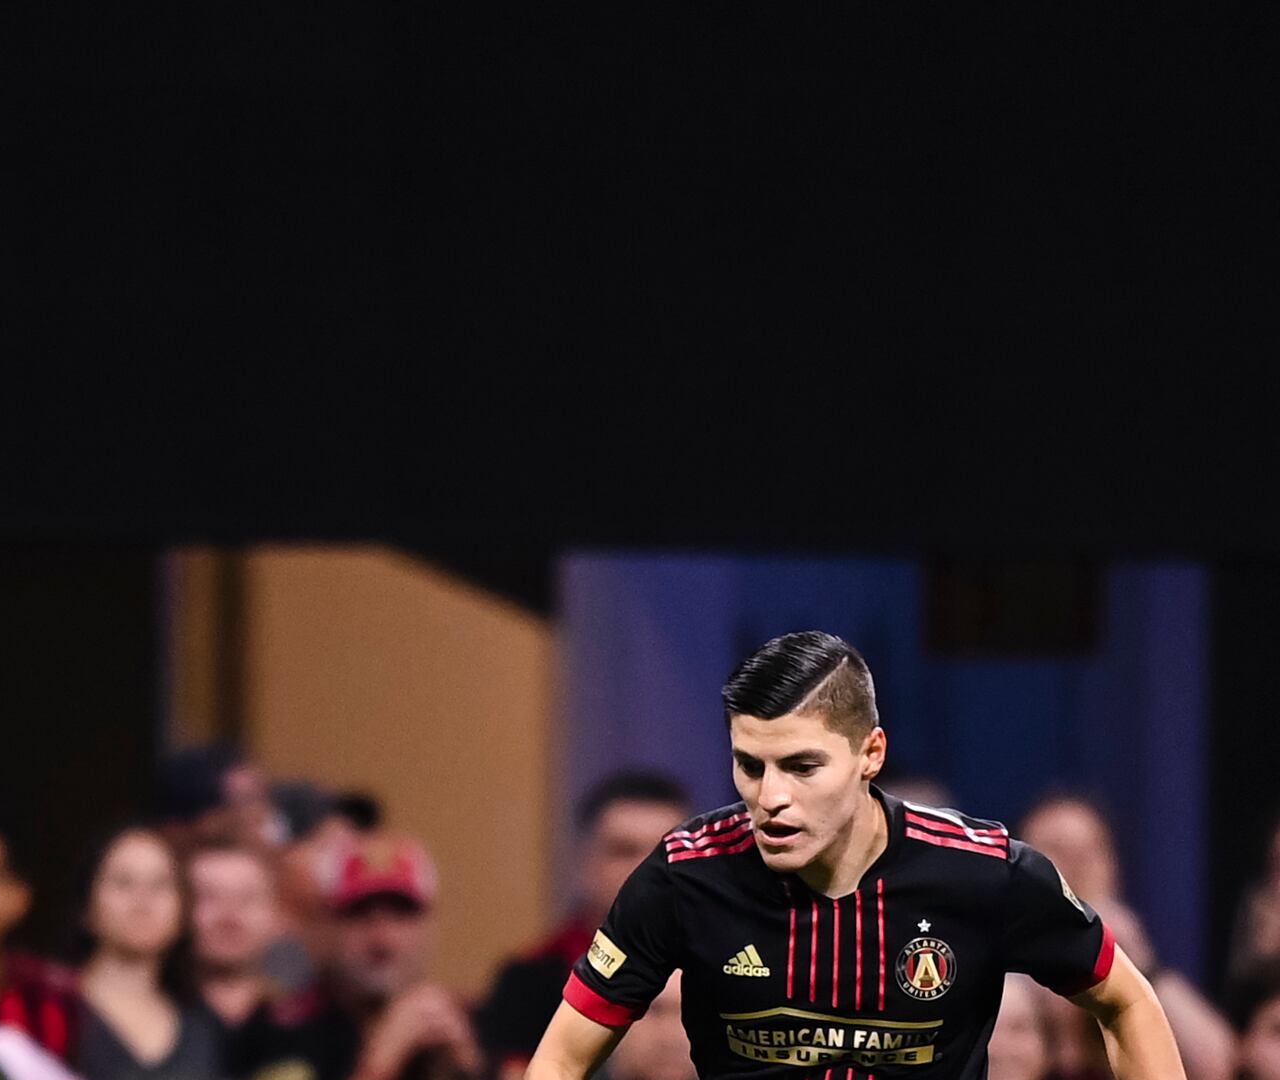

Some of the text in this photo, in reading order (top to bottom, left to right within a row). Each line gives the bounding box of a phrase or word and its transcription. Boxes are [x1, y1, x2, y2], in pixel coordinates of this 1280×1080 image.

[904, 939, 948, 956] ATLANTA
[722, 963, 771, 978] adidas
[902, 981, 938, 998] UNITED
[725, 1024, 846, 1049] AMERICAN
